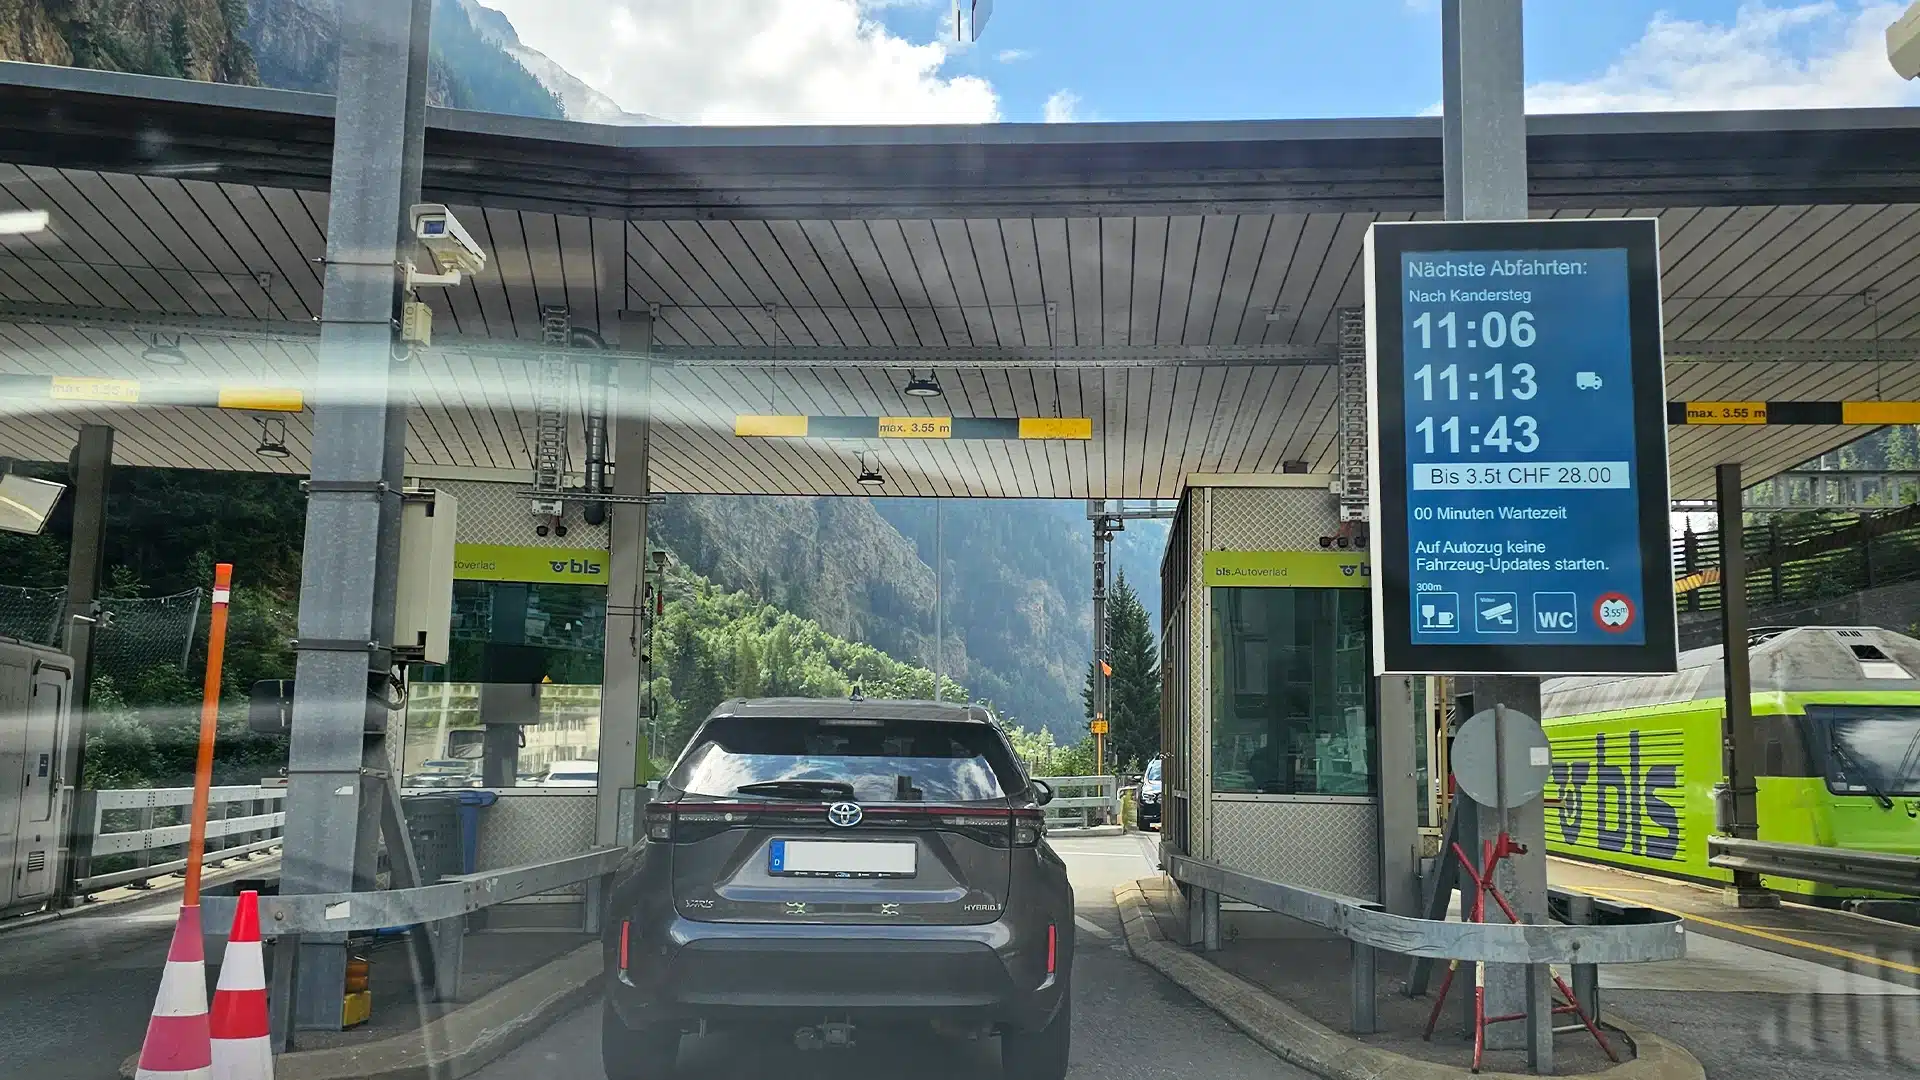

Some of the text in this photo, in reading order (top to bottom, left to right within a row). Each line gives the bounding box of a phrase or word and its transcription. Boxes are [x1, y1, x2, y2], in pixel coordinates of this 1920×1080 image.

[1409, 259, 1588, 278] Nächste Abfahrten:
[1409, 289, 1532, 303] Nach Kandersteg
[1412, 311, 1537, 349] 11:06
[1413, 362, 1538, 401] 11:13
[91, 384, 121, 395] 355
[1688, 408, 1766, 418] max. 3.55 m
[880, 424, 906, 432] max.
[911, 423, 935, 432] 3.55
[1415, 415, 1540, 454] 11:43
[1431, 466, 1611, 484] Bis 3.5t CHF 28.00
[1414, 506, 1567, 520] 00 Minuten Wartezeit
[1415, 541, 1546, 556] Auf Autozug keine
[570, 559, 601, 574] bls
[1216, 567, 1287, 576] bls.Autoverlad
[1416, 558, 1610, 573] Fahrzeug-Updates starten.
[1416, 582, 1442, 591] 300m
[1538, 612, 1574, 628] WC
[1596, 730, 1679, 860] bls
